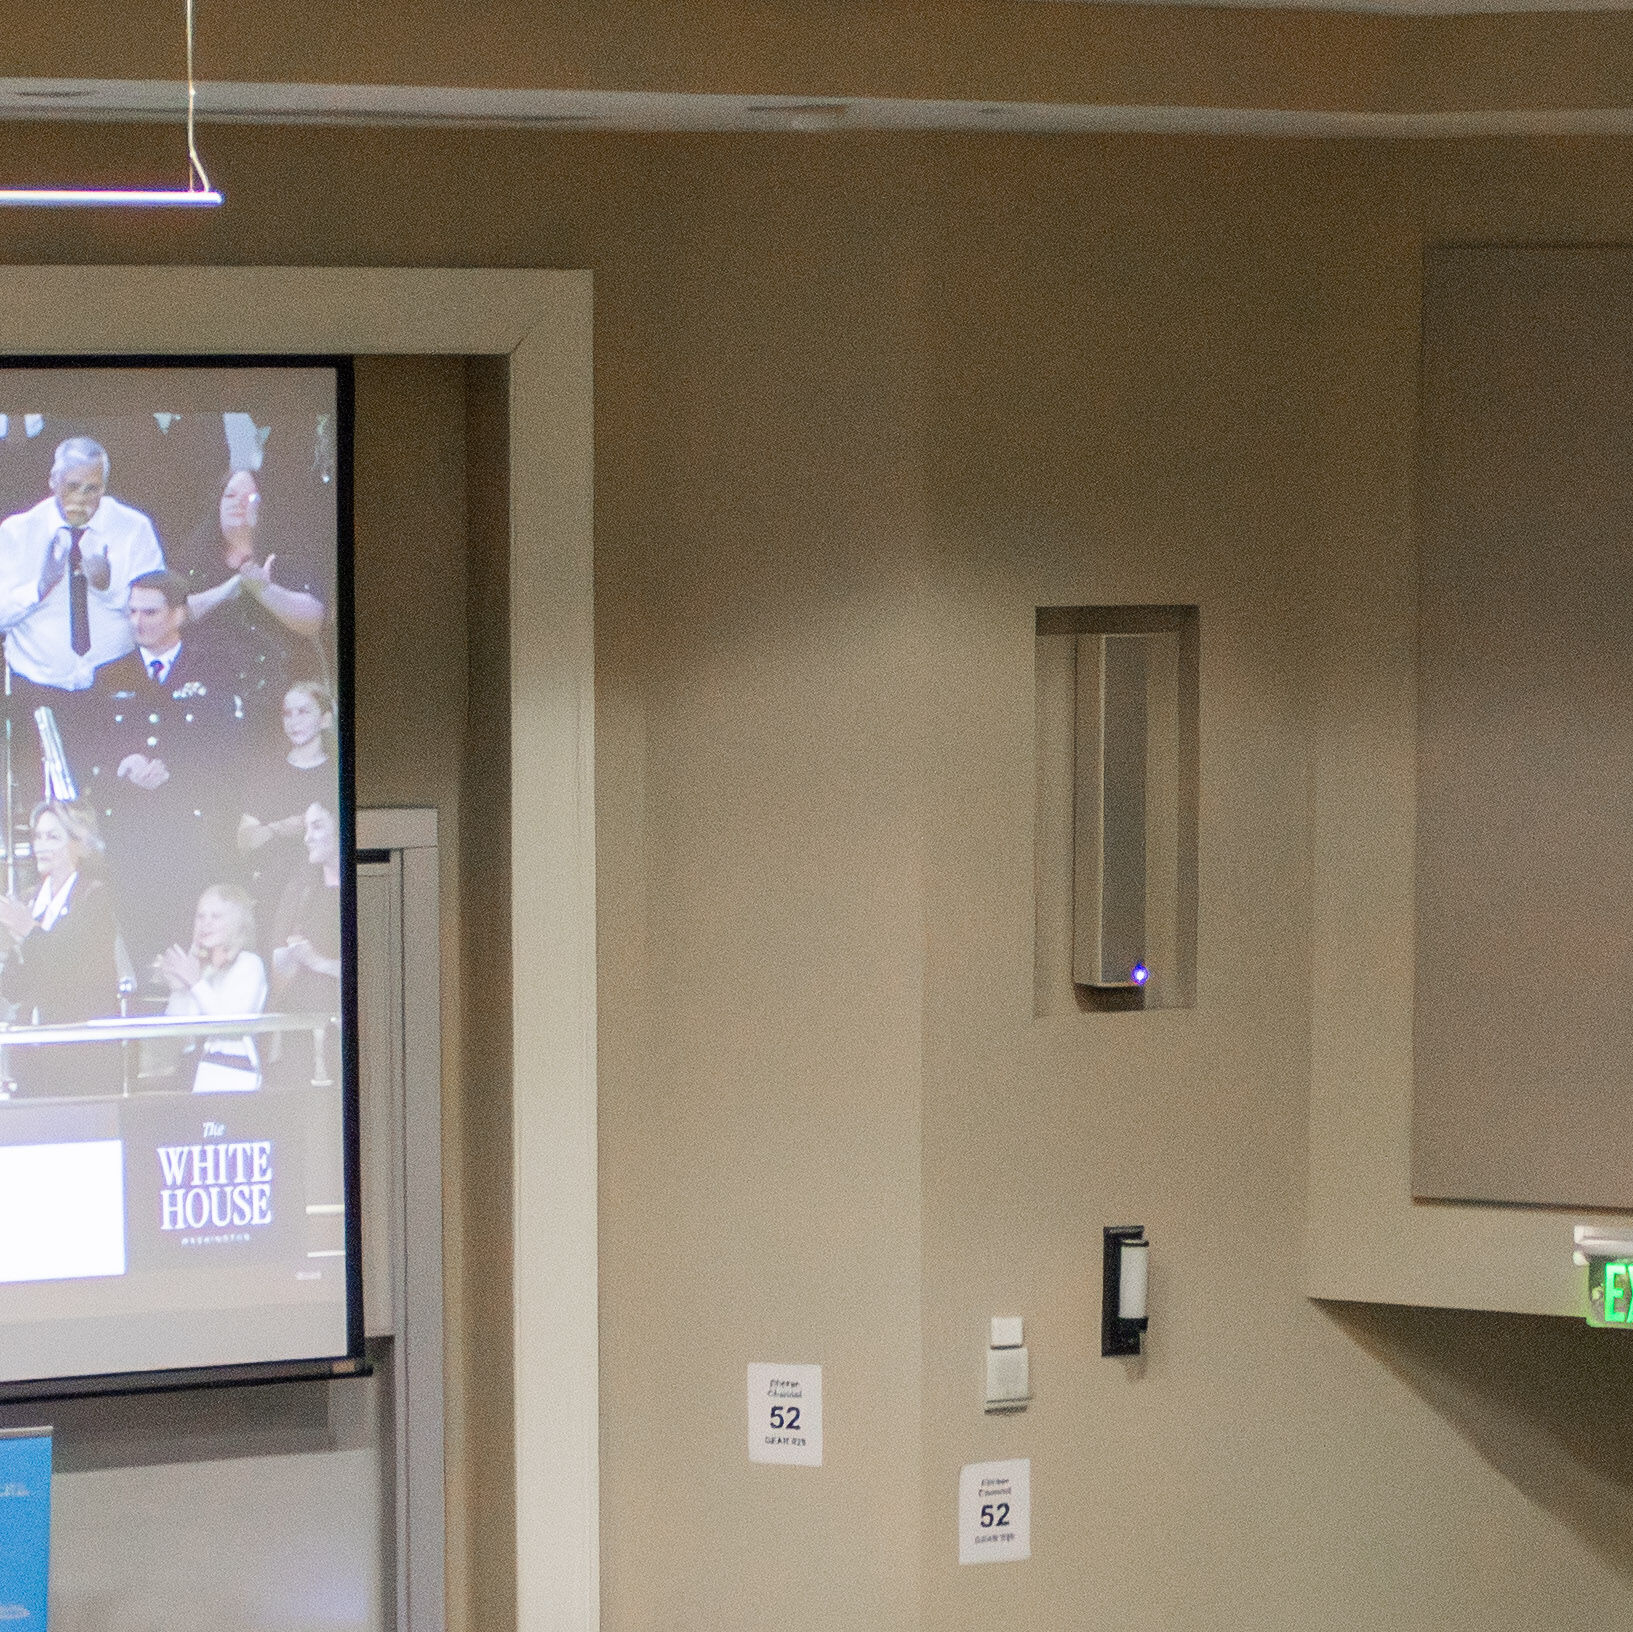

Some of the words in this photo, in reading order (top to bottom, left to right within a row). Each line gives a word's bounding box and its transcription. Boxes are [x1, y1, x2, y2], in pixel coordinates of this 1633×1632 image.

[202, 1121, 227, 1138] The
[156, 1141, 273, 1186] WHITE
[160, 1183, 273, 1230] HOUSE
[770, 1405, 801, 1430] 52
[980, 1502, 1010, 1528] 52
